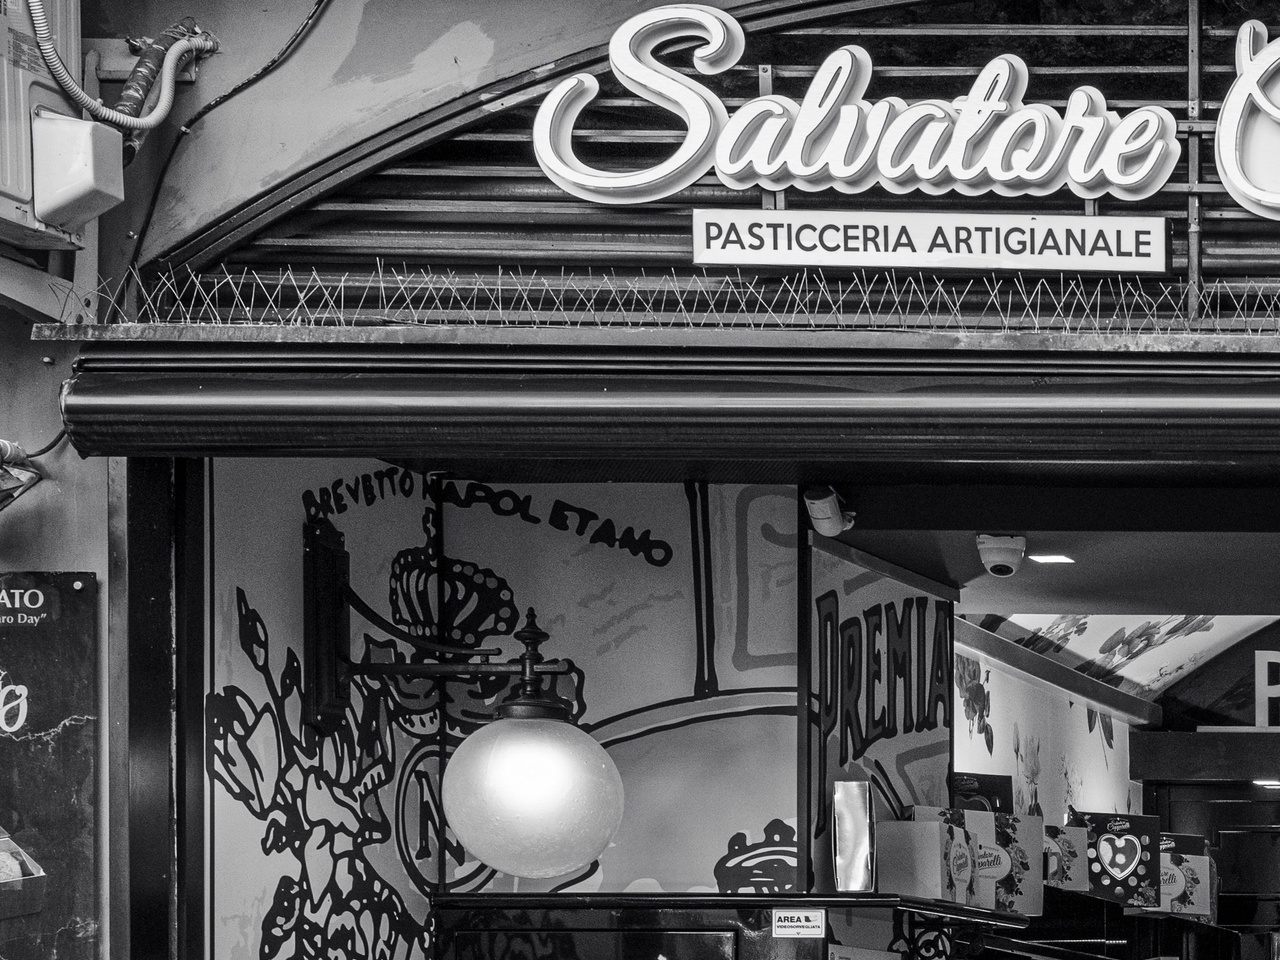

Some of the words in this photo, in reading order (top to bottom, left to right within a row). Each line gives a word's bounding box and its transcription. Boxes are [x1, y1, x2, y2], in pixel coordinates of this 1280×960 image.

[533, 4, 1181, 202] Salvatore
[705, 222, 916, 254] PASTICCERIA
[927, 226, 1152, 258] ARTIGIANALE
[0, 615, 14, 624] ro
